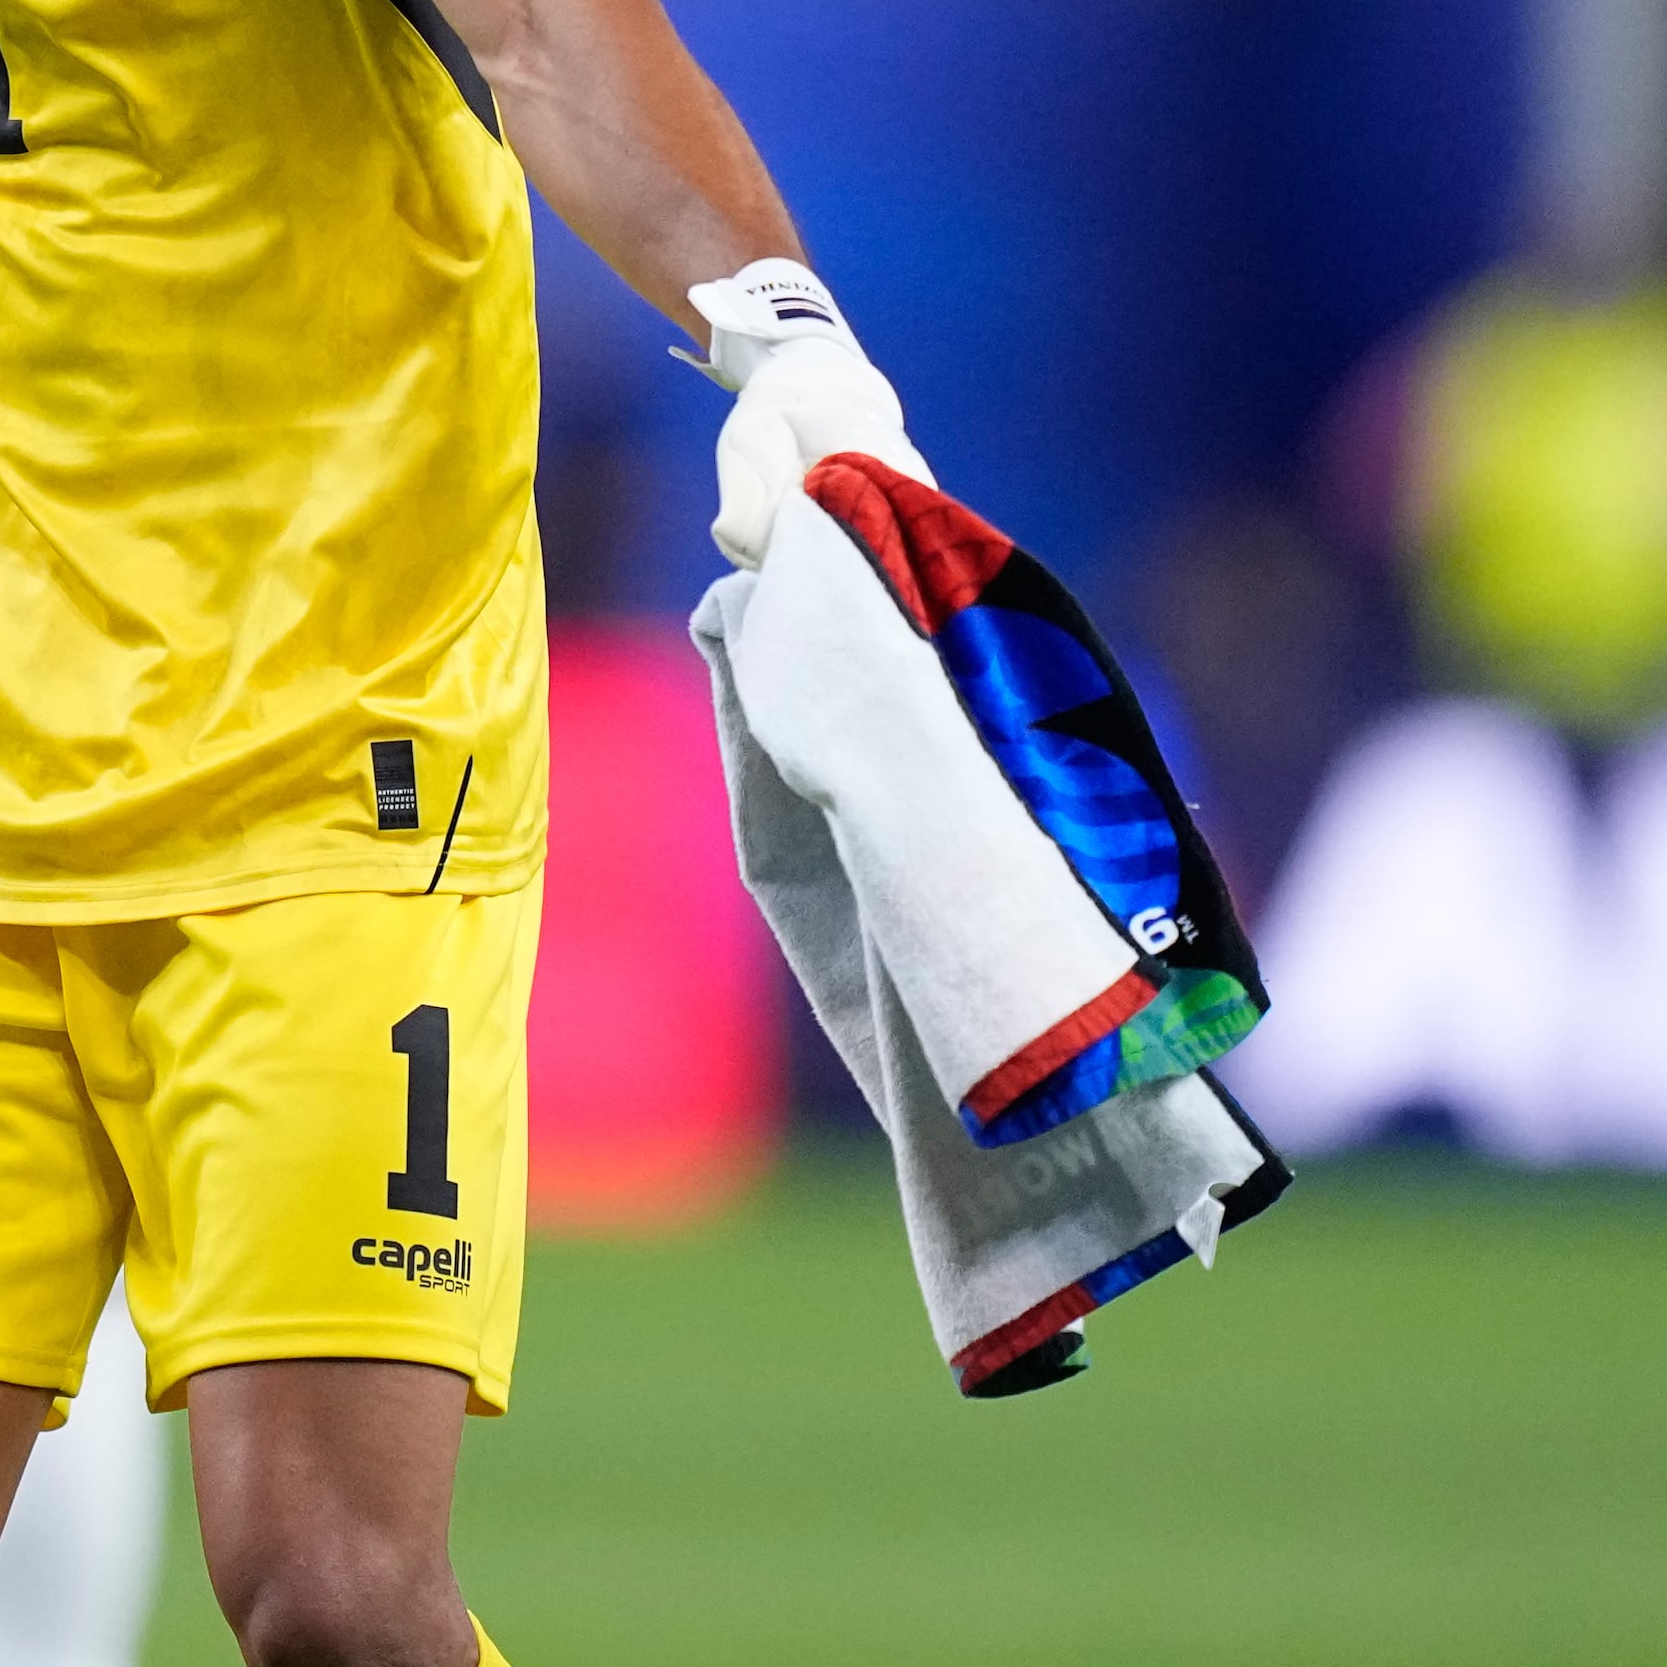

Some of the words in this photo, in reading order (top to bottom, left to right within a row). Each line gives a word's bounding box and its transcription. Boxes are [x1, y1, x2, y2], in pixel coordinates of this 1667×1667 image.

[378, 795, 415, 803] LICENSED
[378, 803, 415, 811] PRODUCT
[1129, 905, 1180, 955] 6
[387, 1004, 458, 1220] 1
[352, 1237, 472, 1282] capelli
[419, 1274, 470, 1297] SPORT
